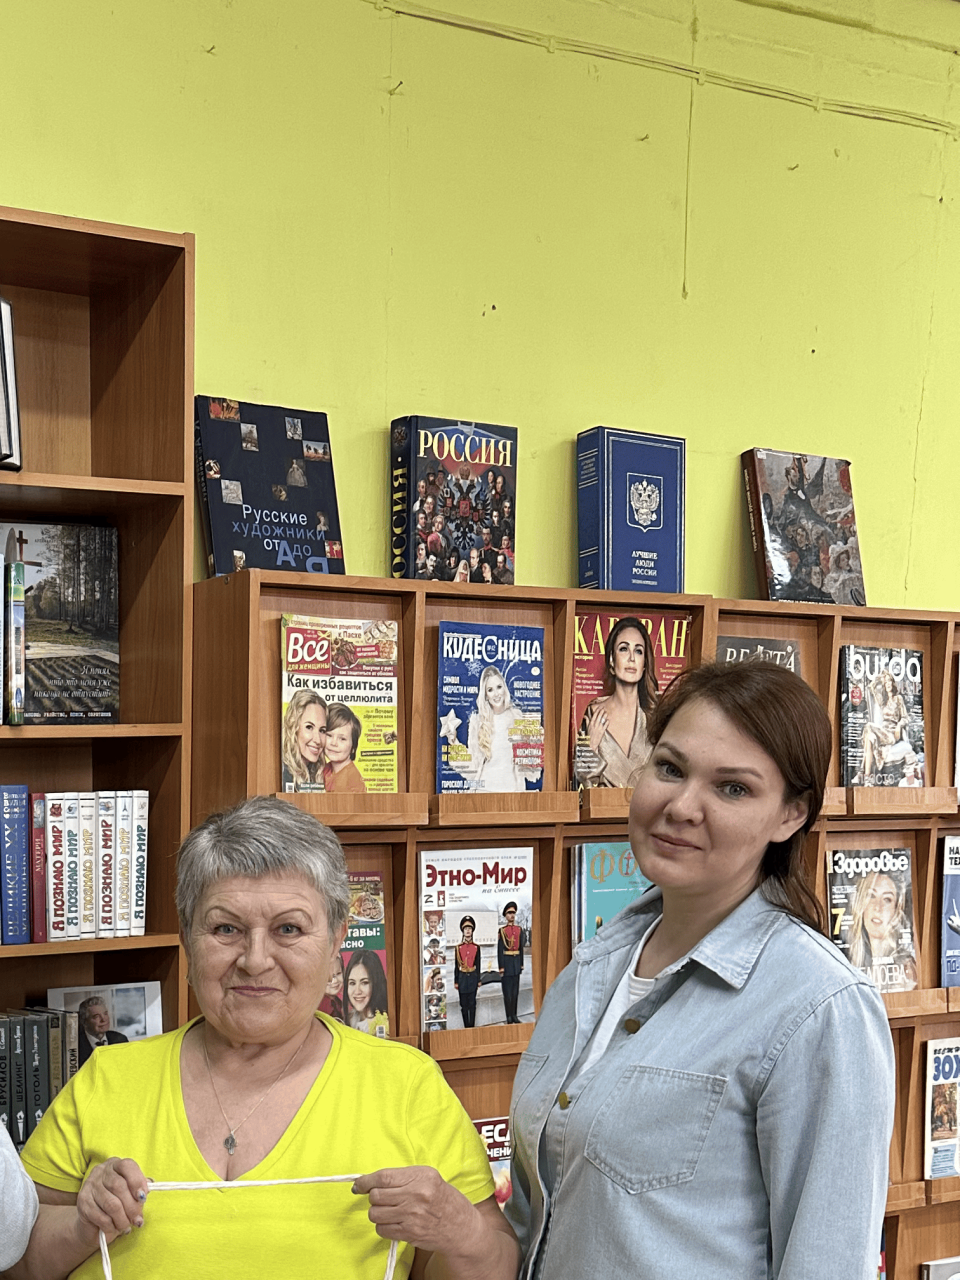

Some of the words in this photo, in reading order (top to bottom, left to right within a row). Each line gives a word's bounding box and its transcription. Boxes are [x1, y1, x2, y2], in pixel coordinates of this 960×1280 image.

[417, 430, 513, 467] РОССИЯ
[243, 504, 307, 525] Русские
[392, 467, 407, 578] ОССИЯ
[232, 521, 325, 540] художники
[264, 539, 280, 550] от
[276, 540, 296, 567] А
[292, 544, 311, 559] до
[632, 551, 658, 560] ЛУЧШИЕ
[633, 568, 657, 576] РОССИИ
[287, 633, 329, 662] Все
[574, 614, 688, 658] КААН
[443, 636, 541, 664] КУДЕСНИЦА
[850, 645, 920, 682] burda
[287, 675, 309, 688] Как
[313, 677, 392, 691] избавиться
[325, 693, 335, 701] от
[338, 694, 392, 703] целлюлита
[52, 825, 63, 856] МИР
[67, 830, 78, 857] МИР
[101, 819, 112, 849] МИР
[137, 825, 146, 852] МИР
[426, 862, 527, 887] Этно-Мир
[834, 851, 908, 879] Здоровье
[6, 854, 19, 935] ВЕЛИКИЕ
[53, 860, 64, 917] ПОЗНАЮ
[68, 861, 78, 913] ПОЗНАЮ
[102, 853, 112, 913] ПОЗНАЮ
[136, 855, 145, 907] ПОЗНАЮ
[53, 920, 64, 931] Я
[67, 917, 78, 926] Я
[102, 916, 112, 925] Я
[134, 910, 144, 919] Я
[831, 908, 845, 935] 7
[341, 940, 364, 948] асно
[348, 928, 380, 937] тавы:
